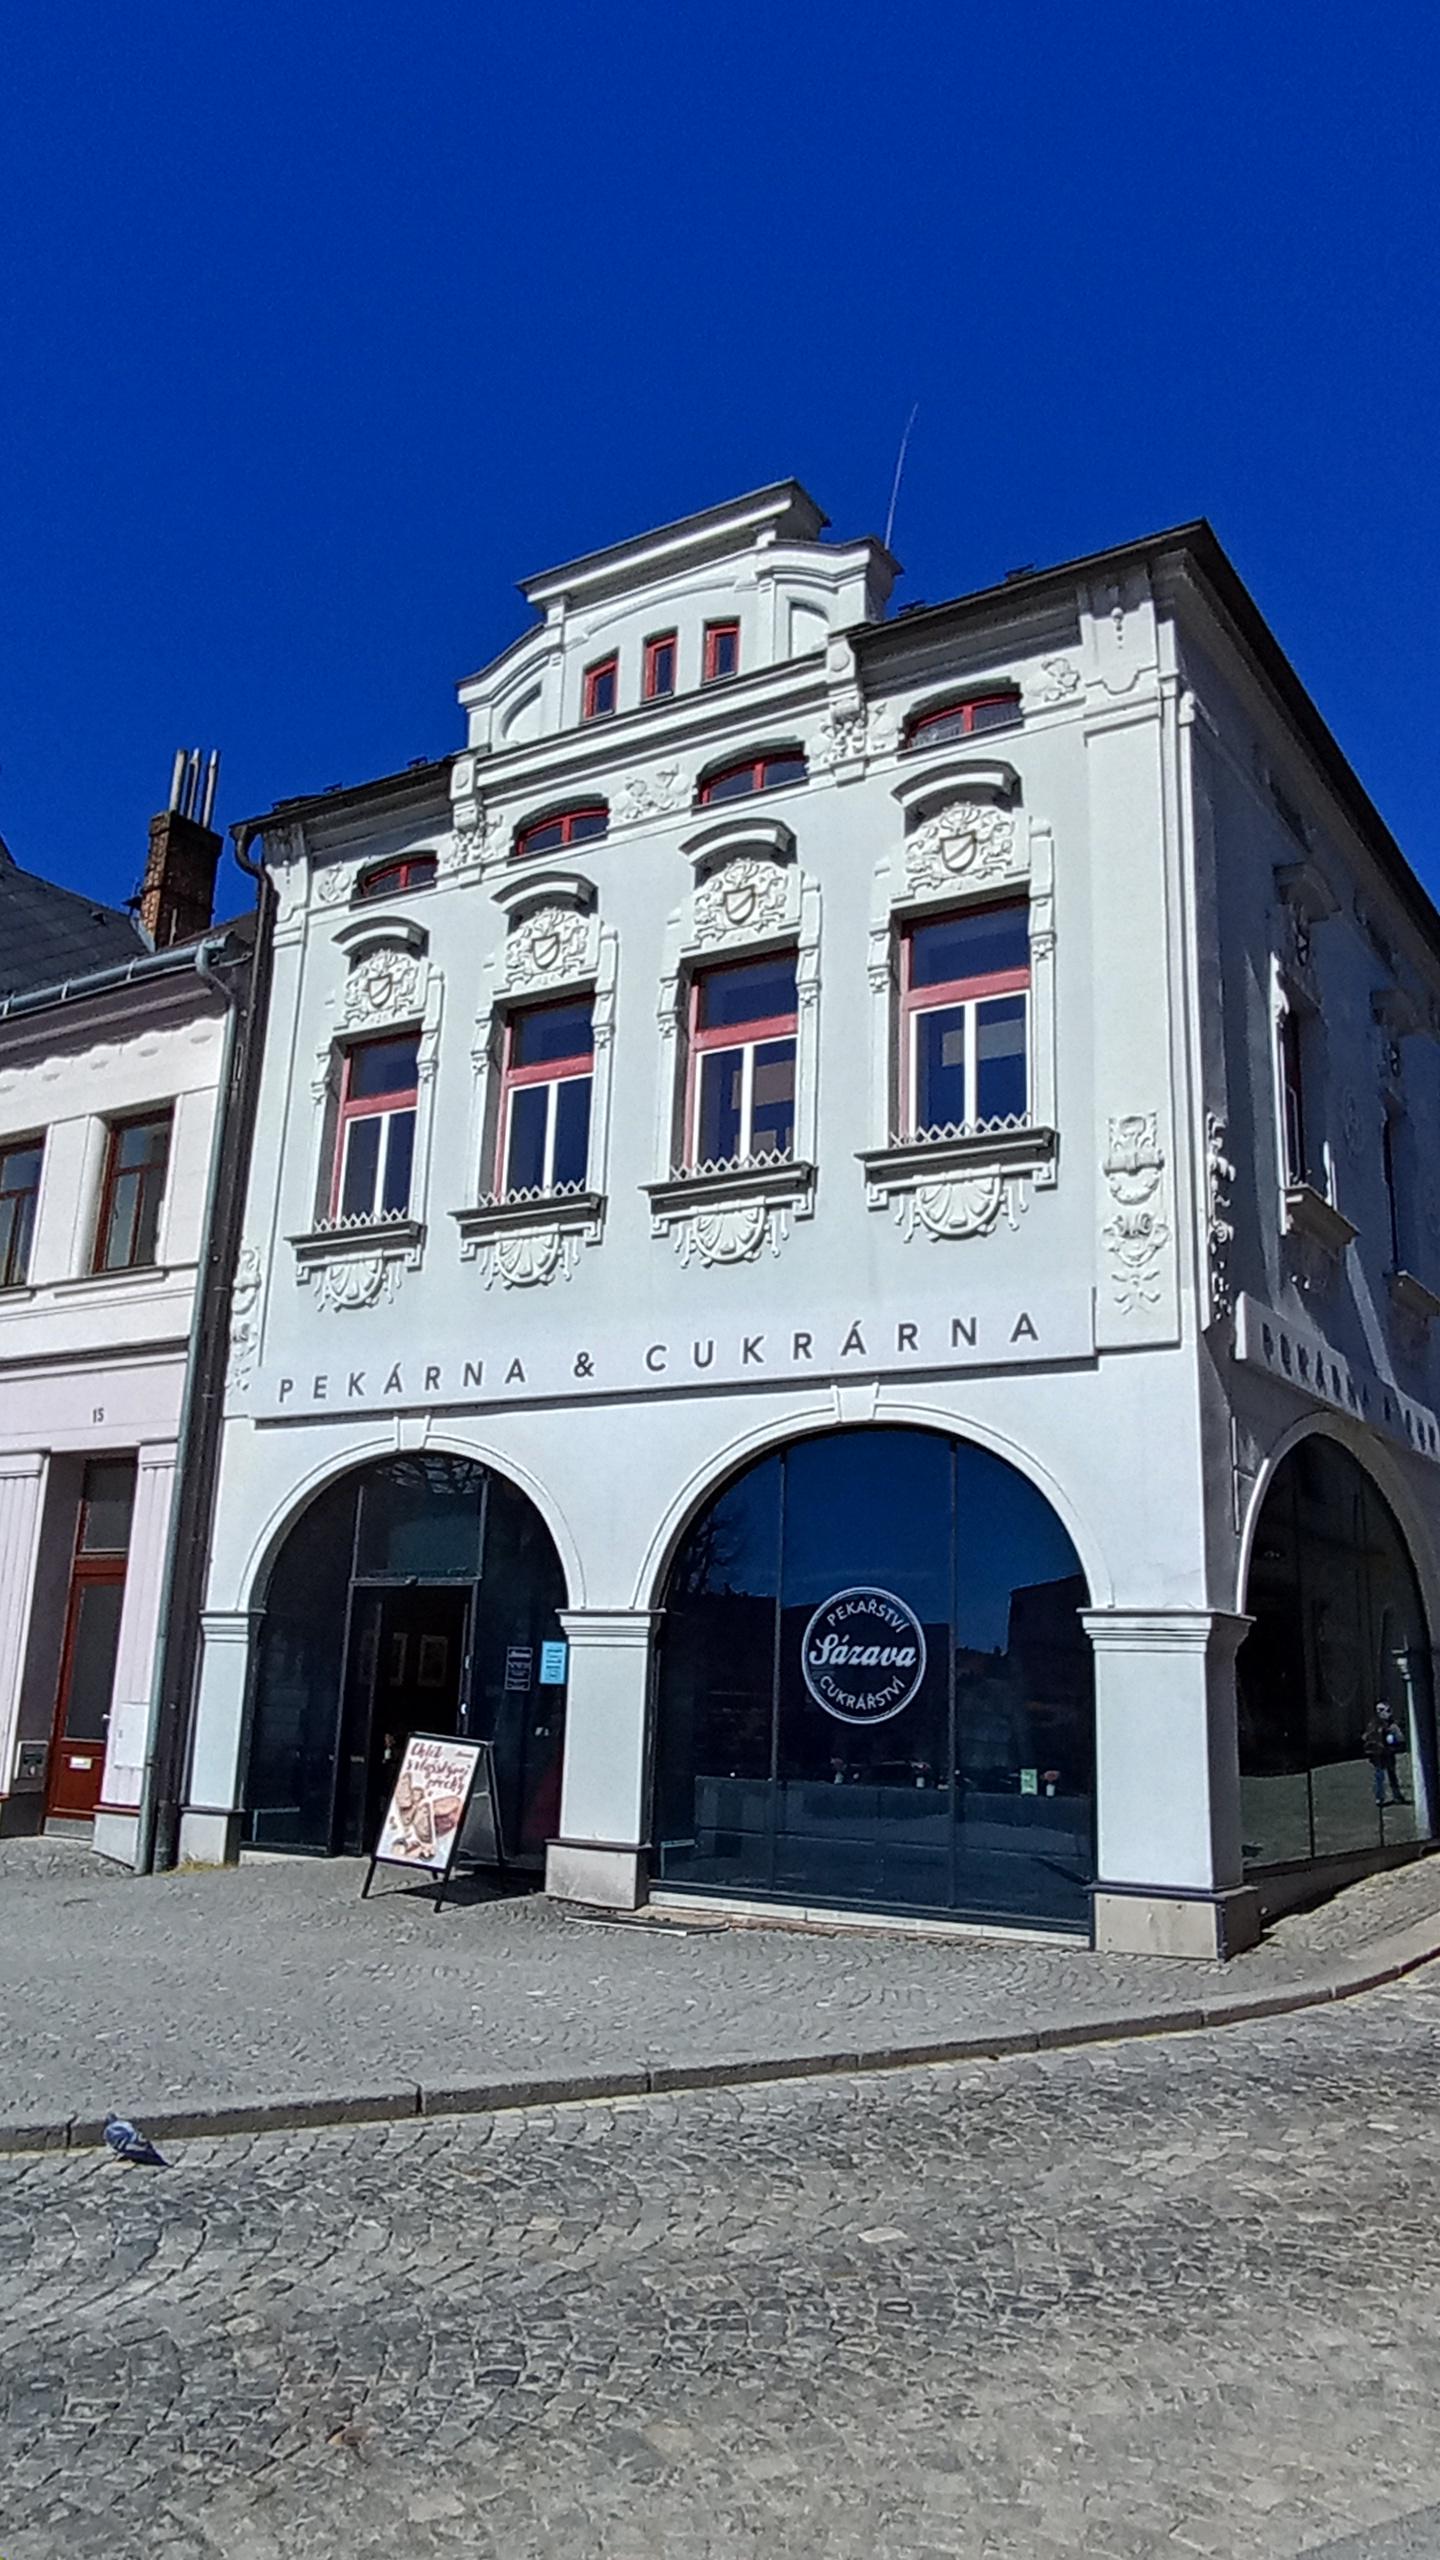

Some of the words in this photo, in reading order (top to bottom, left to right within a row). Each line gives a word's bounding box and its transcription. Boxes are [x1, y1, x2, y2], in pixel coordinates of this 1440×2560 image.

[279, 1359, 526, 1402] PEKÁRNA
[574, 1352, 595, 1377] &
[646, 1313, 1039, 1371] CUKRÁRNA
[92, 1407, 104, 1424] 15
[827, 1599, 910, 1633] PEKAŘSTVÍ
[809, 1633, 917, 1667] Sázava
[820, 1675, 906, 1710] CUKRÁŘSTVÍ
